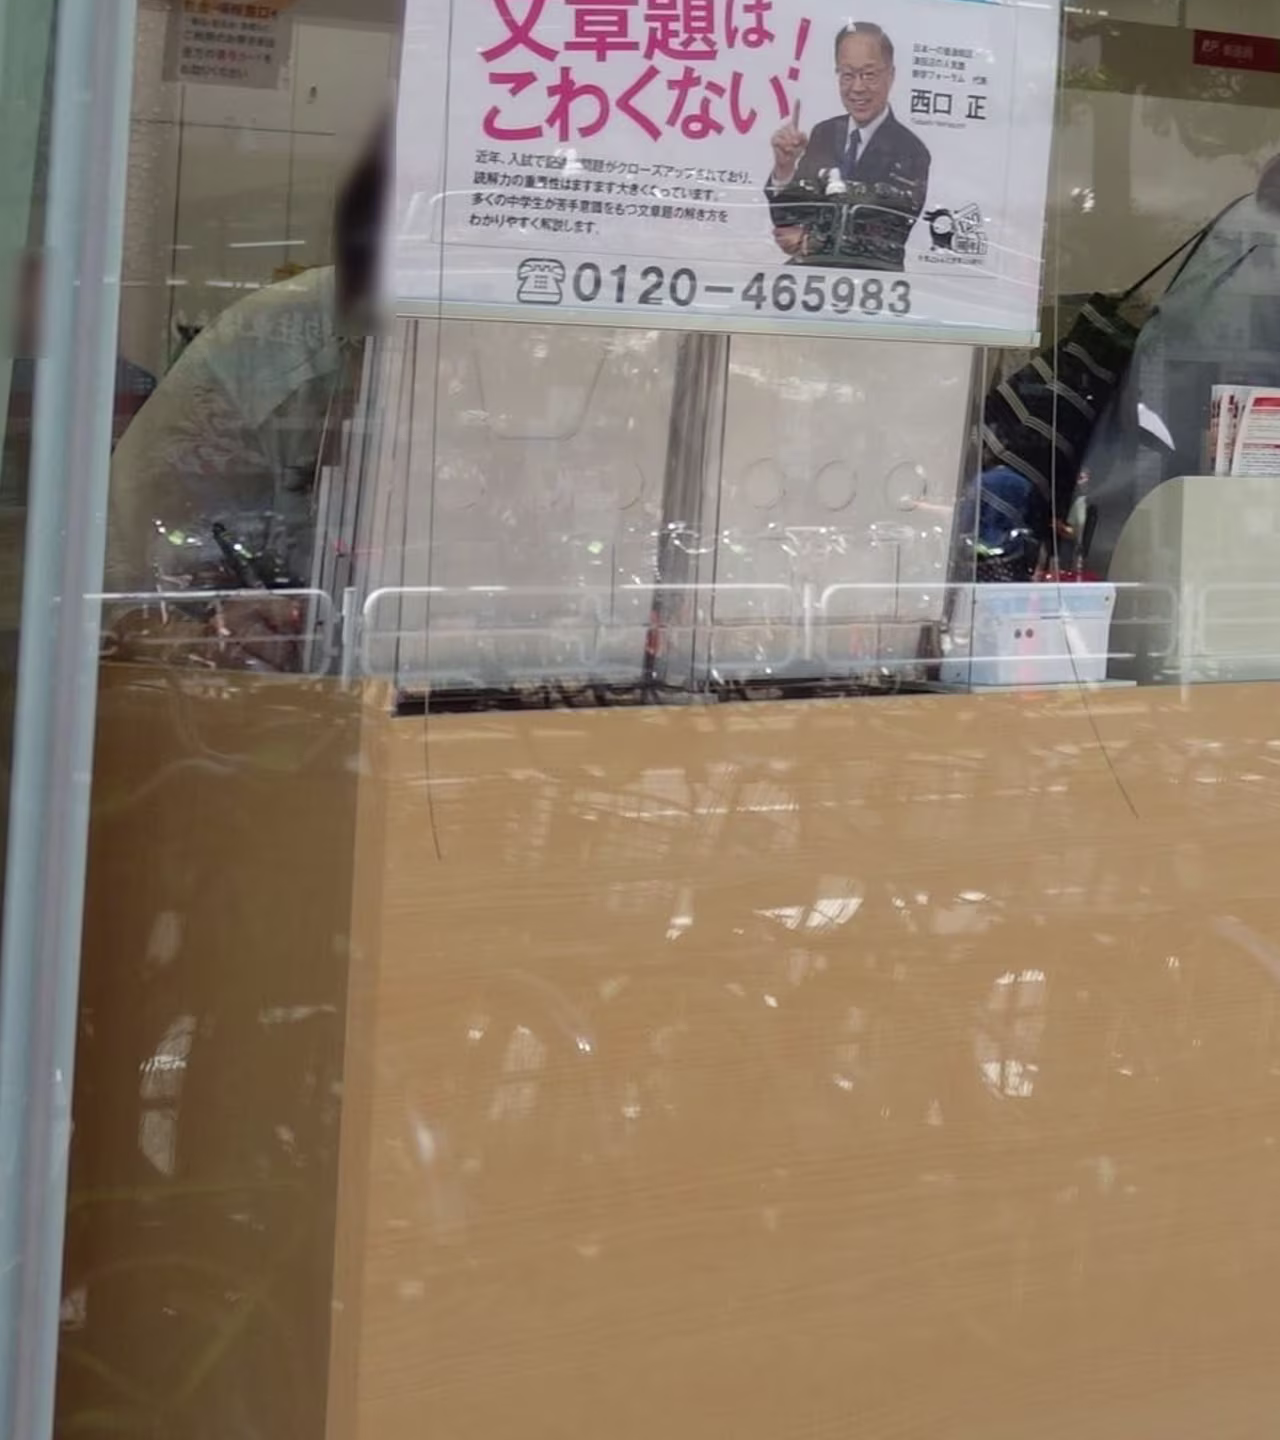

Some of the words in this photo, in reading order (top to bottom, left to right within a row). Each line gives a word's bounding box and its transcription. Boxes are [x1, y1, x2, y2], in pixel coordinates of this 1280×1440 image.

[910, 88, 953, 116] 西口
[964, 94, 988, 121] 正
[572, 261, 912, 317] 0120-465983
